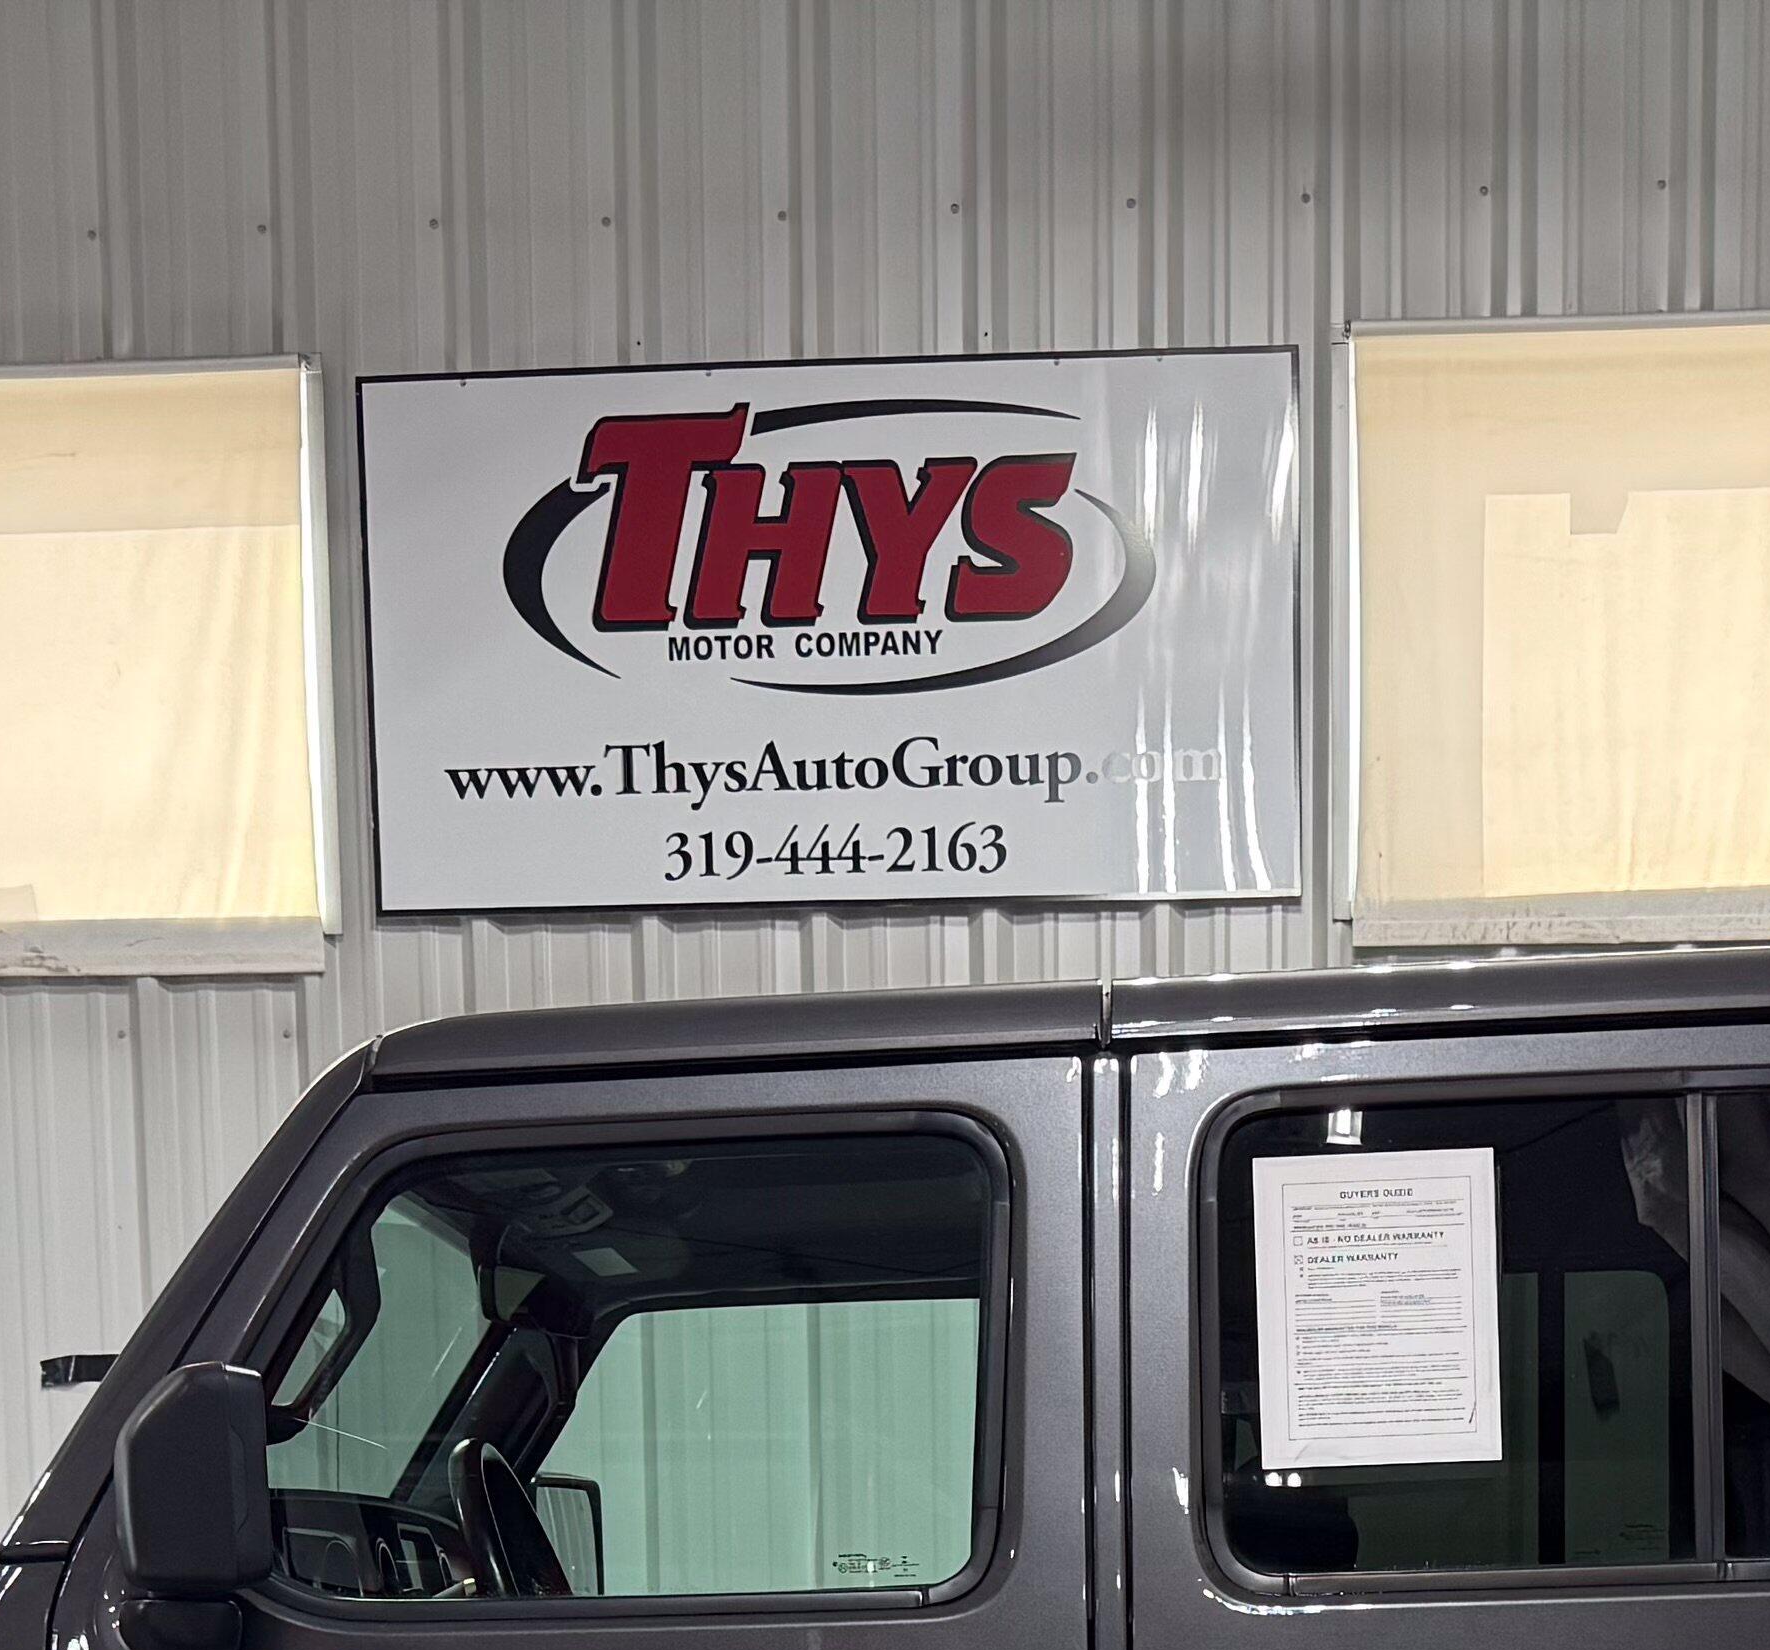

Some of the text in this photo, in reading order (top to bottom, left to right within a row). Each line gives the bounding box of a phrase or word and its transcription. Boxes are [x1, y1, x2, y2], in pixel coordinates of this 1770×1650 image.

[571, 402, 1079, 632] THYS
[668, 629, 944, 663] MOTOR COMPANY
[665, 821, 1008, 882] 319-444-2163
